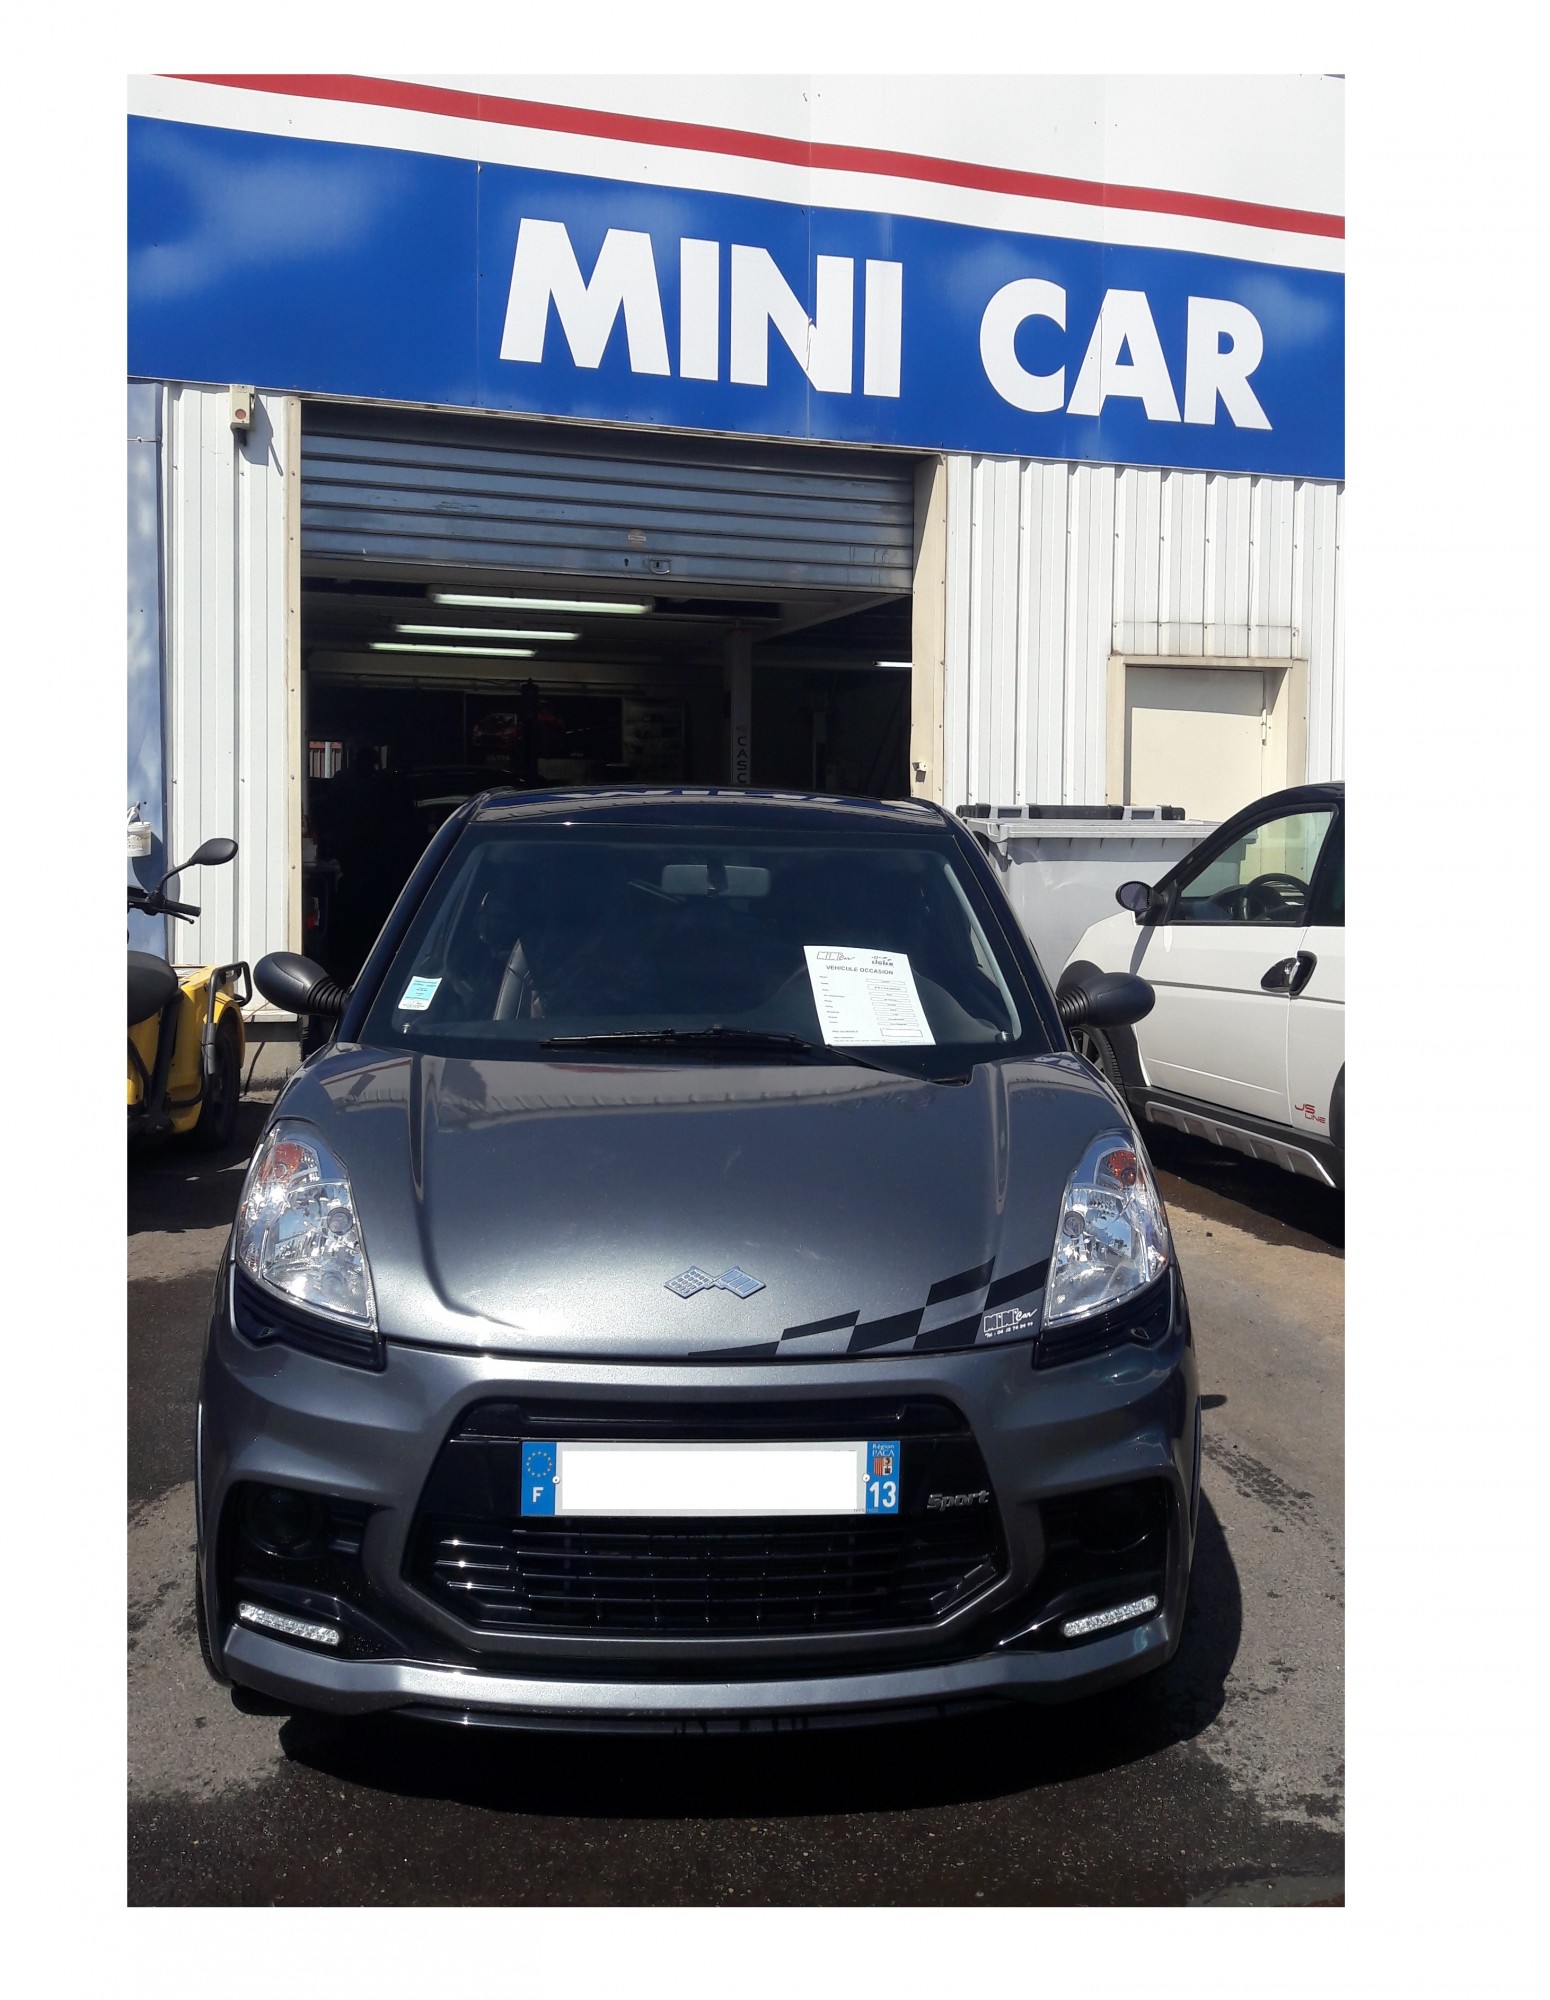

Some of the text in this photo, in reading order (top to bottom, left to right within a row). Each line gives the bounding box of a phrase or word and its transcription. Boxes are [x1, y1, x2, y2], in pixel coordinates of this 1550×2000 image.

[499, 217, 1273, 431] MINI CAR
[825, 965, 894, 975] VEHICULE OCCASION
[1294, 1103, 1315, 1115] JS
[1304, 1113, 1326, 1124] LINE
[1015, 1308, 1038, 1322] Car
[872, 1443, 895, 1451] Région
[872, 1449, 895, 1457] PACA
[532, 1481, 897, 1508] F 13
[926, 1490, 990, 1512] Sport
